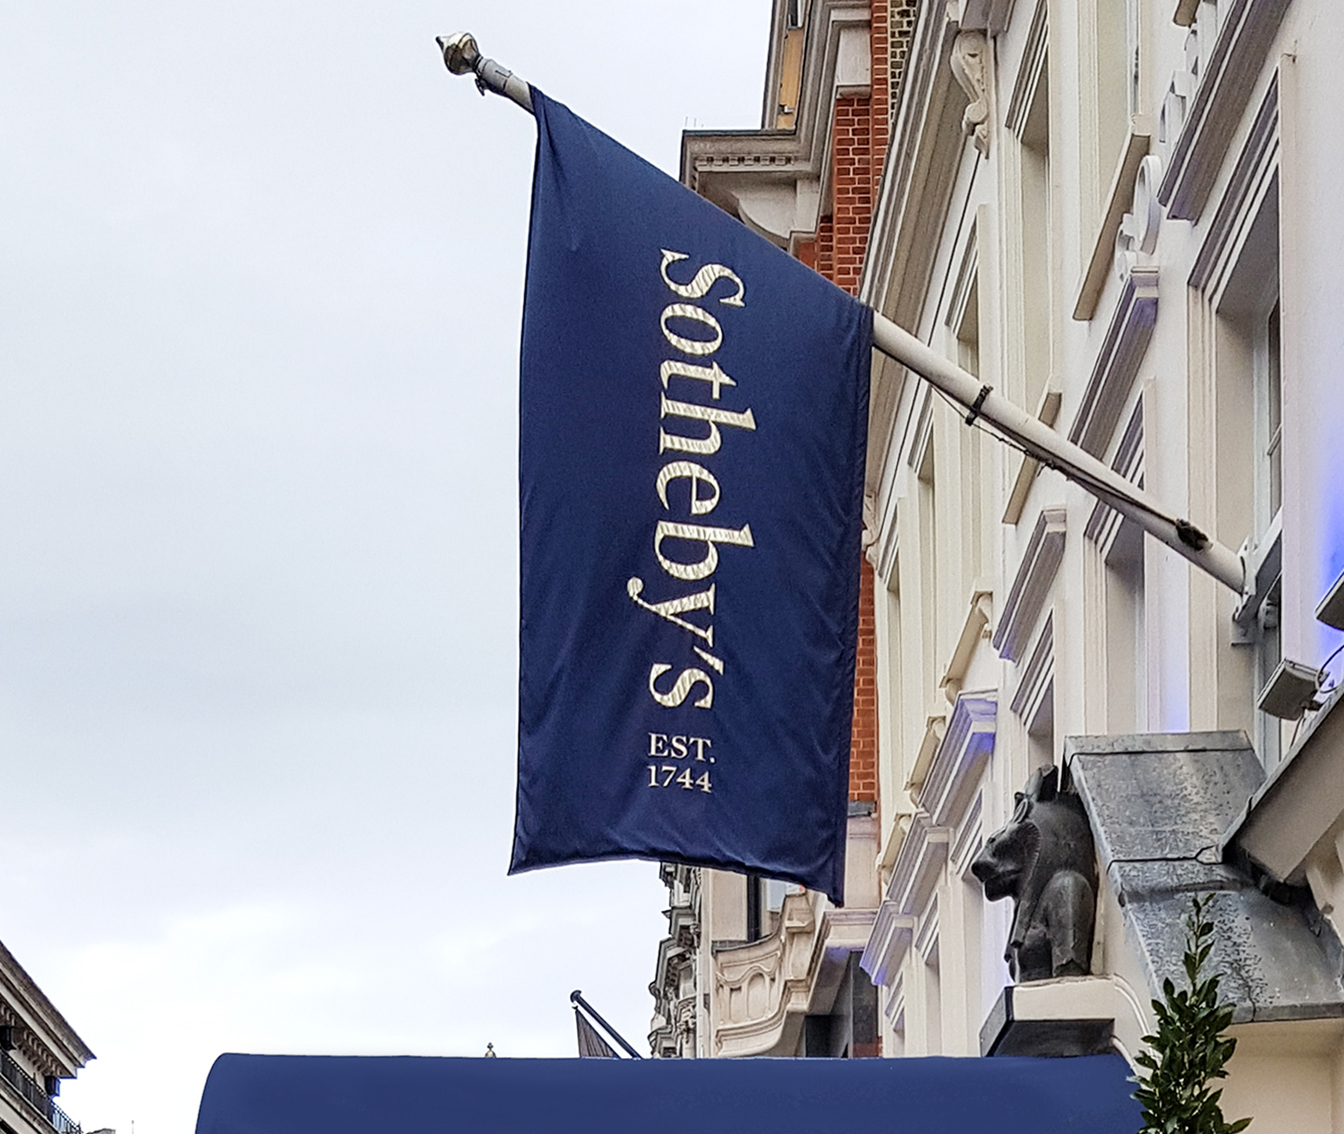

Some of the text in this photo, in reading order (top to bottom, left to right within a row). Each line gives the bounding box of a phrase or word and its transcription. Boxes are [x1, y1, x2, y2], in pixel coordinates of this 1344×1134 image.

[627, 247, 757, 709] Sotheby's
[648, 731, 716, 763] EST.
[648, 765, 713, 793] 1744
